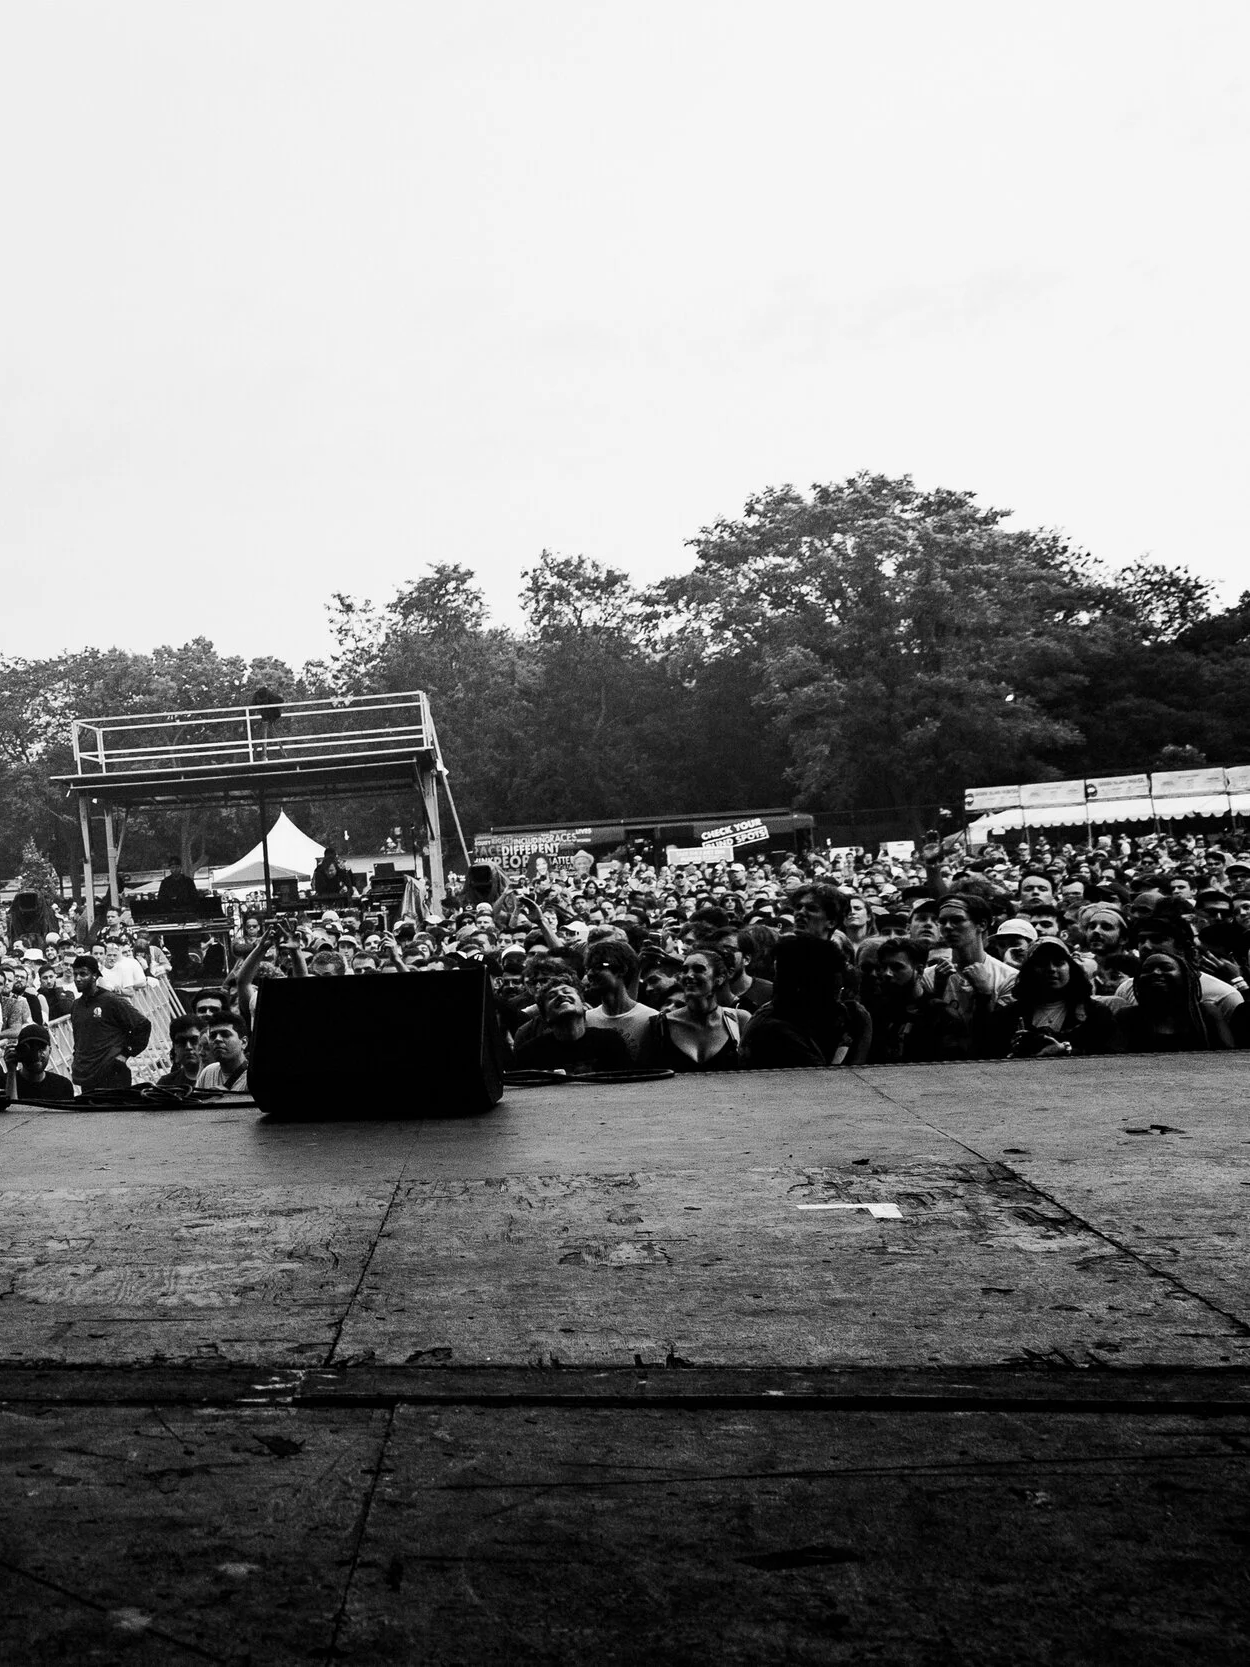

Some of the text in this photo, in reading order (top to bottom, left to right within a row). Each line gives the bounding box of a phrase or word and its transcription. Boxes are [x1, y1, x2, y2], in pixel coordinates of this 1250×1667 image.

[701, 818, 763, 840] CHECK YOUR
[549, 833, 578, 843] RACES
[735, 829, 766, 844] SPOTS
[501, 843, 560, 856] DIFFERENT
[493, 855, 530, 869] PEOP
